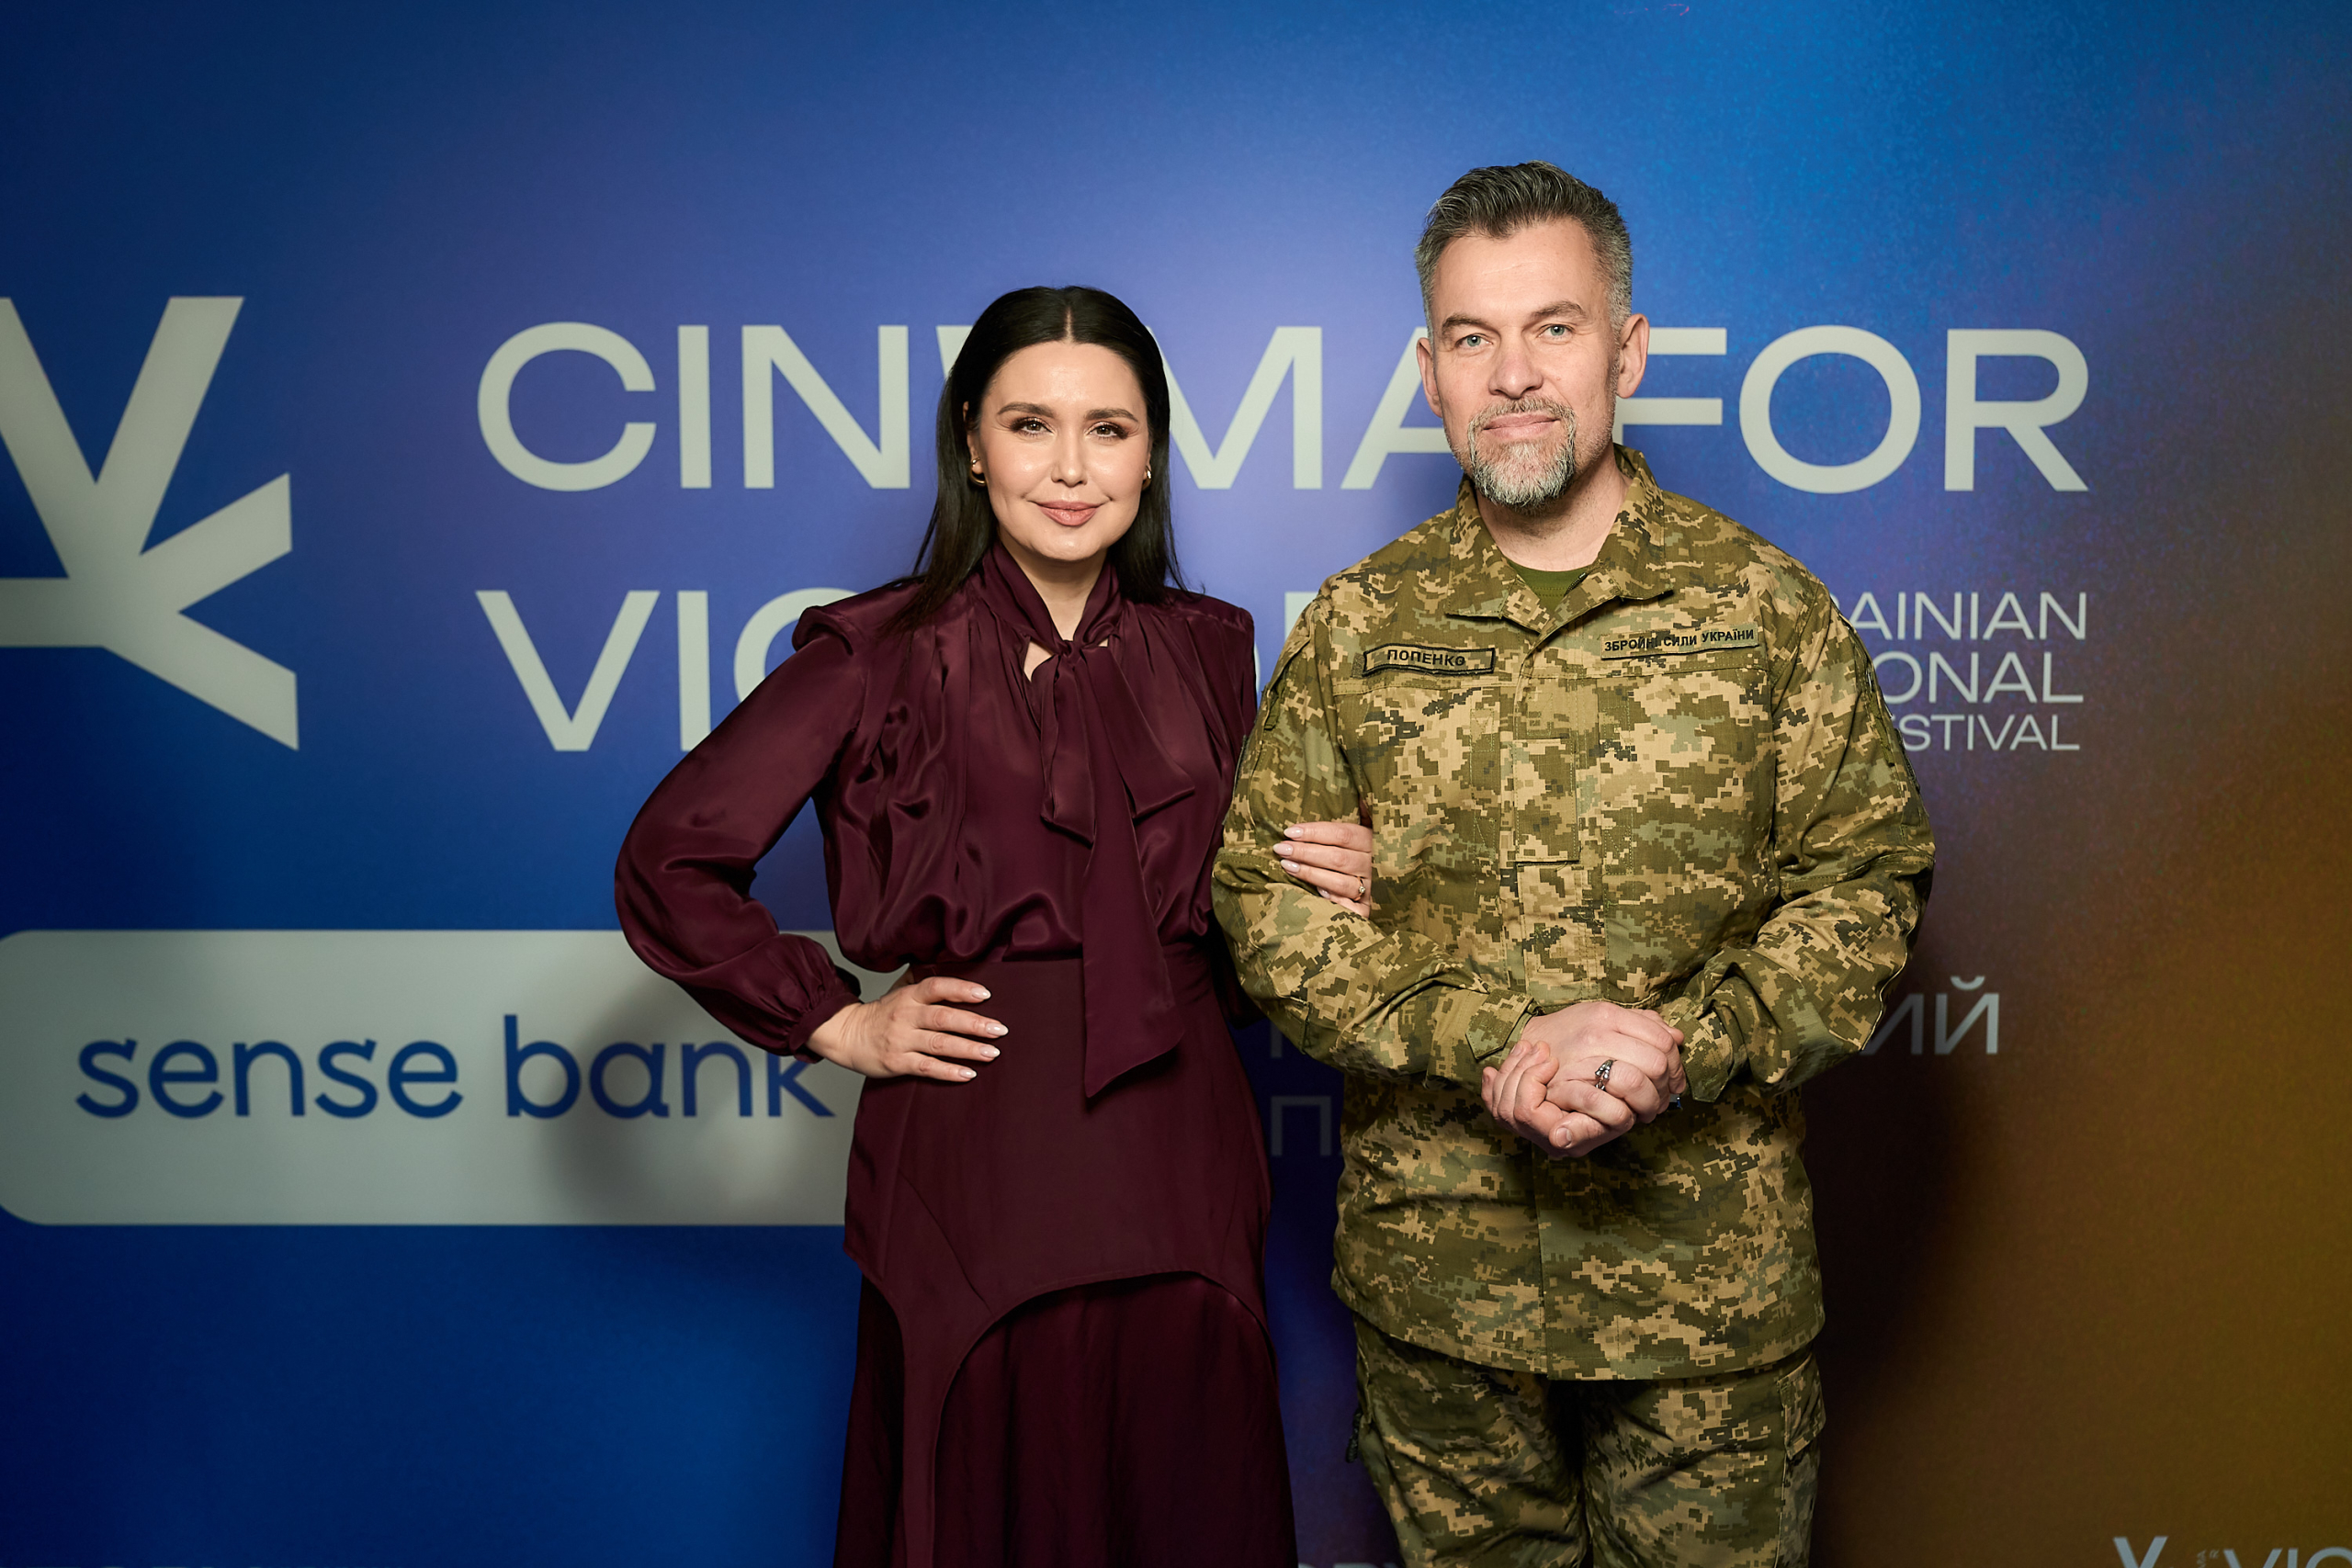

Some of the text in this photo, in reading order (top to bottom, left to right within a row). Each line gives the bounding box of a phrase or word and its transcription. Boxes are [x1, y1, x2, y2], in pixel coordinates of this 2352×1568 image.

[477, 321, 1453, 491] CINMA
[1663, 635, 1697, 648] СИЛИ
[1702, 628, 1754, 644] УКРАЇНИ
[1832, 592, 2086, 640] AINIAN
[1386, 649, 1465, 666] ПОПЕНКО
[1874, 650, 2084, 704] ONAL
[1891, 713, 2080, 751] STIVAL
[75, 1014, 837, 1119] sense bank
